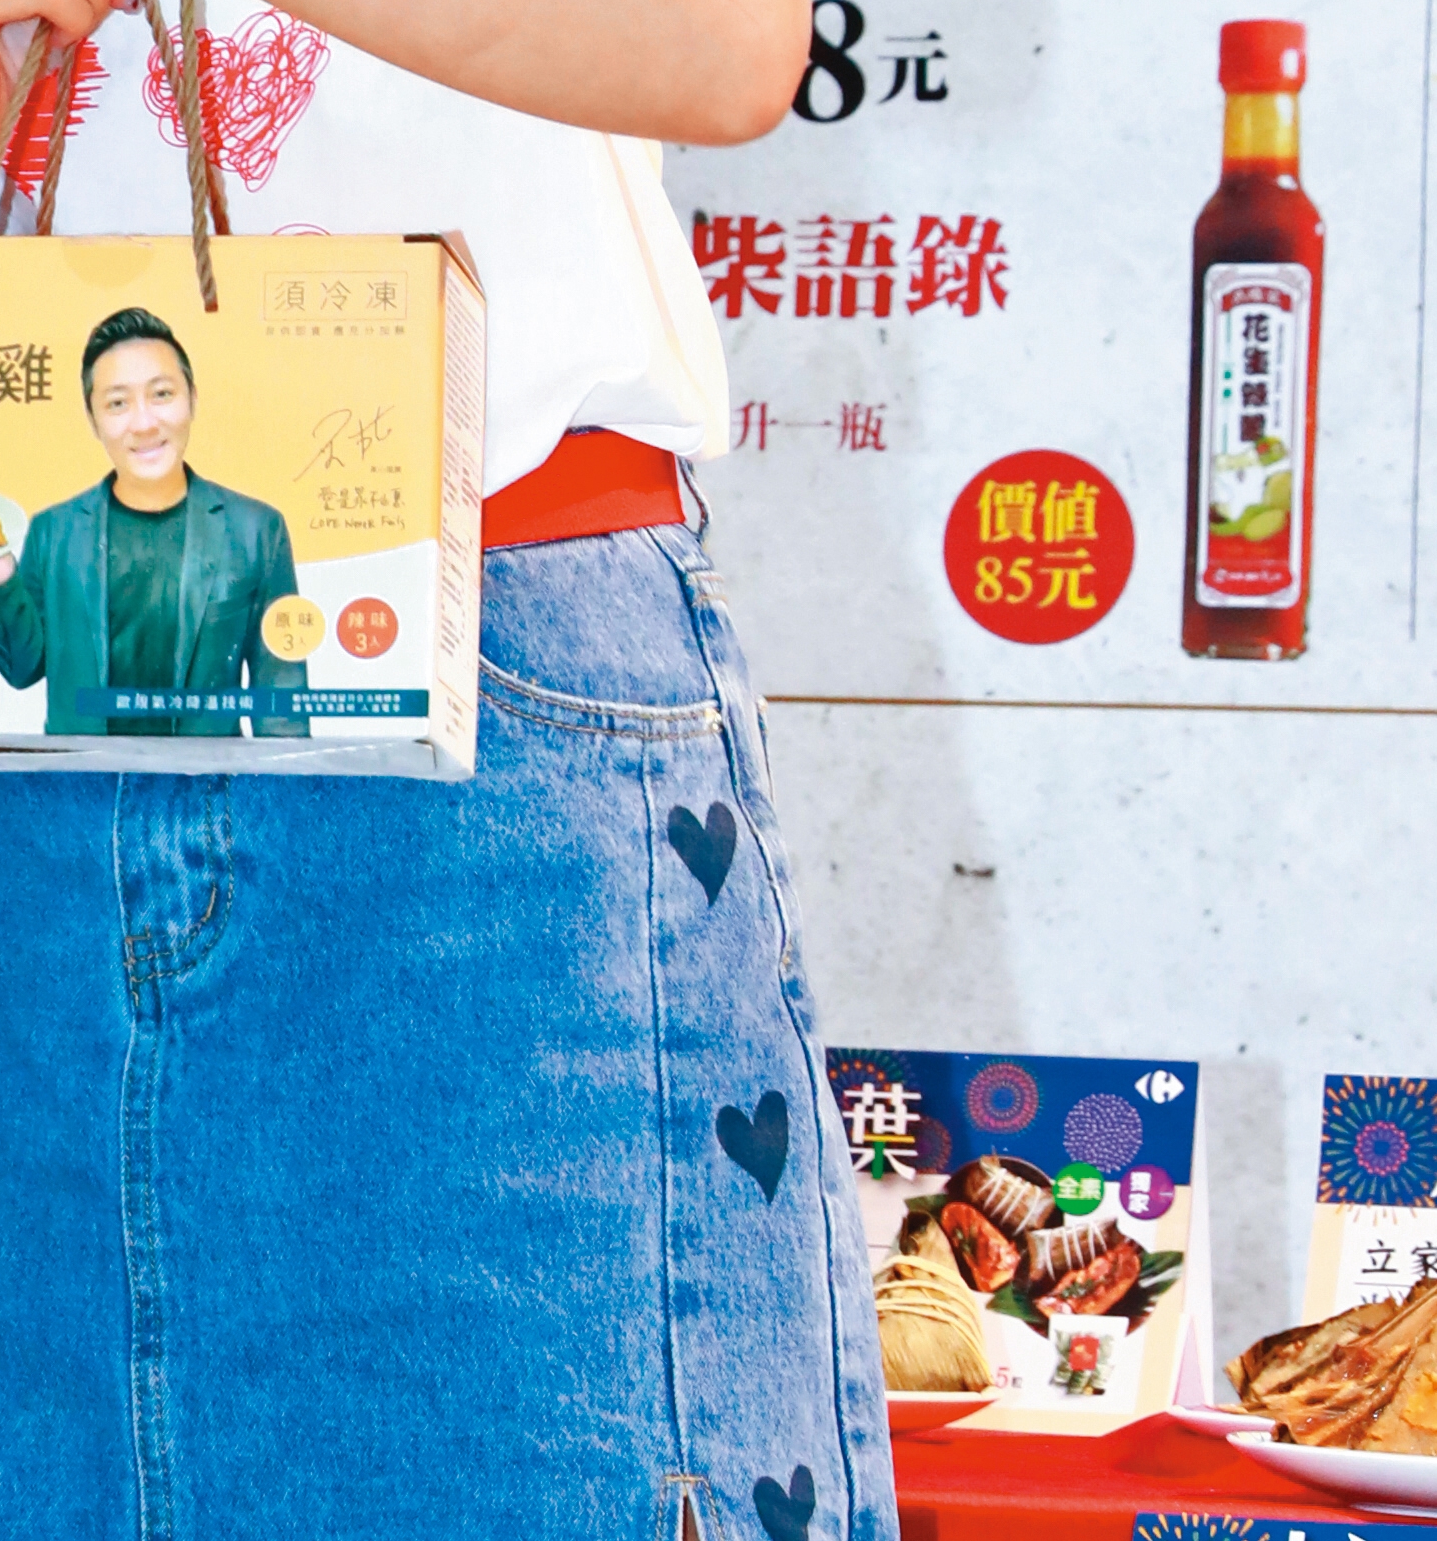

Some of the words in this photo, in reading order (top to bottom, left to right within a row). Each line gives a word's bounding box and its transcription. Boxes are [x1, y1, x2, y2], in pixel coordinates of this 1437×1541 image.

[274, 279, 399, 312] 須冷凍
[978, 479, 1101, 543] 價值
[974, 547, 1098, 610] 85元
